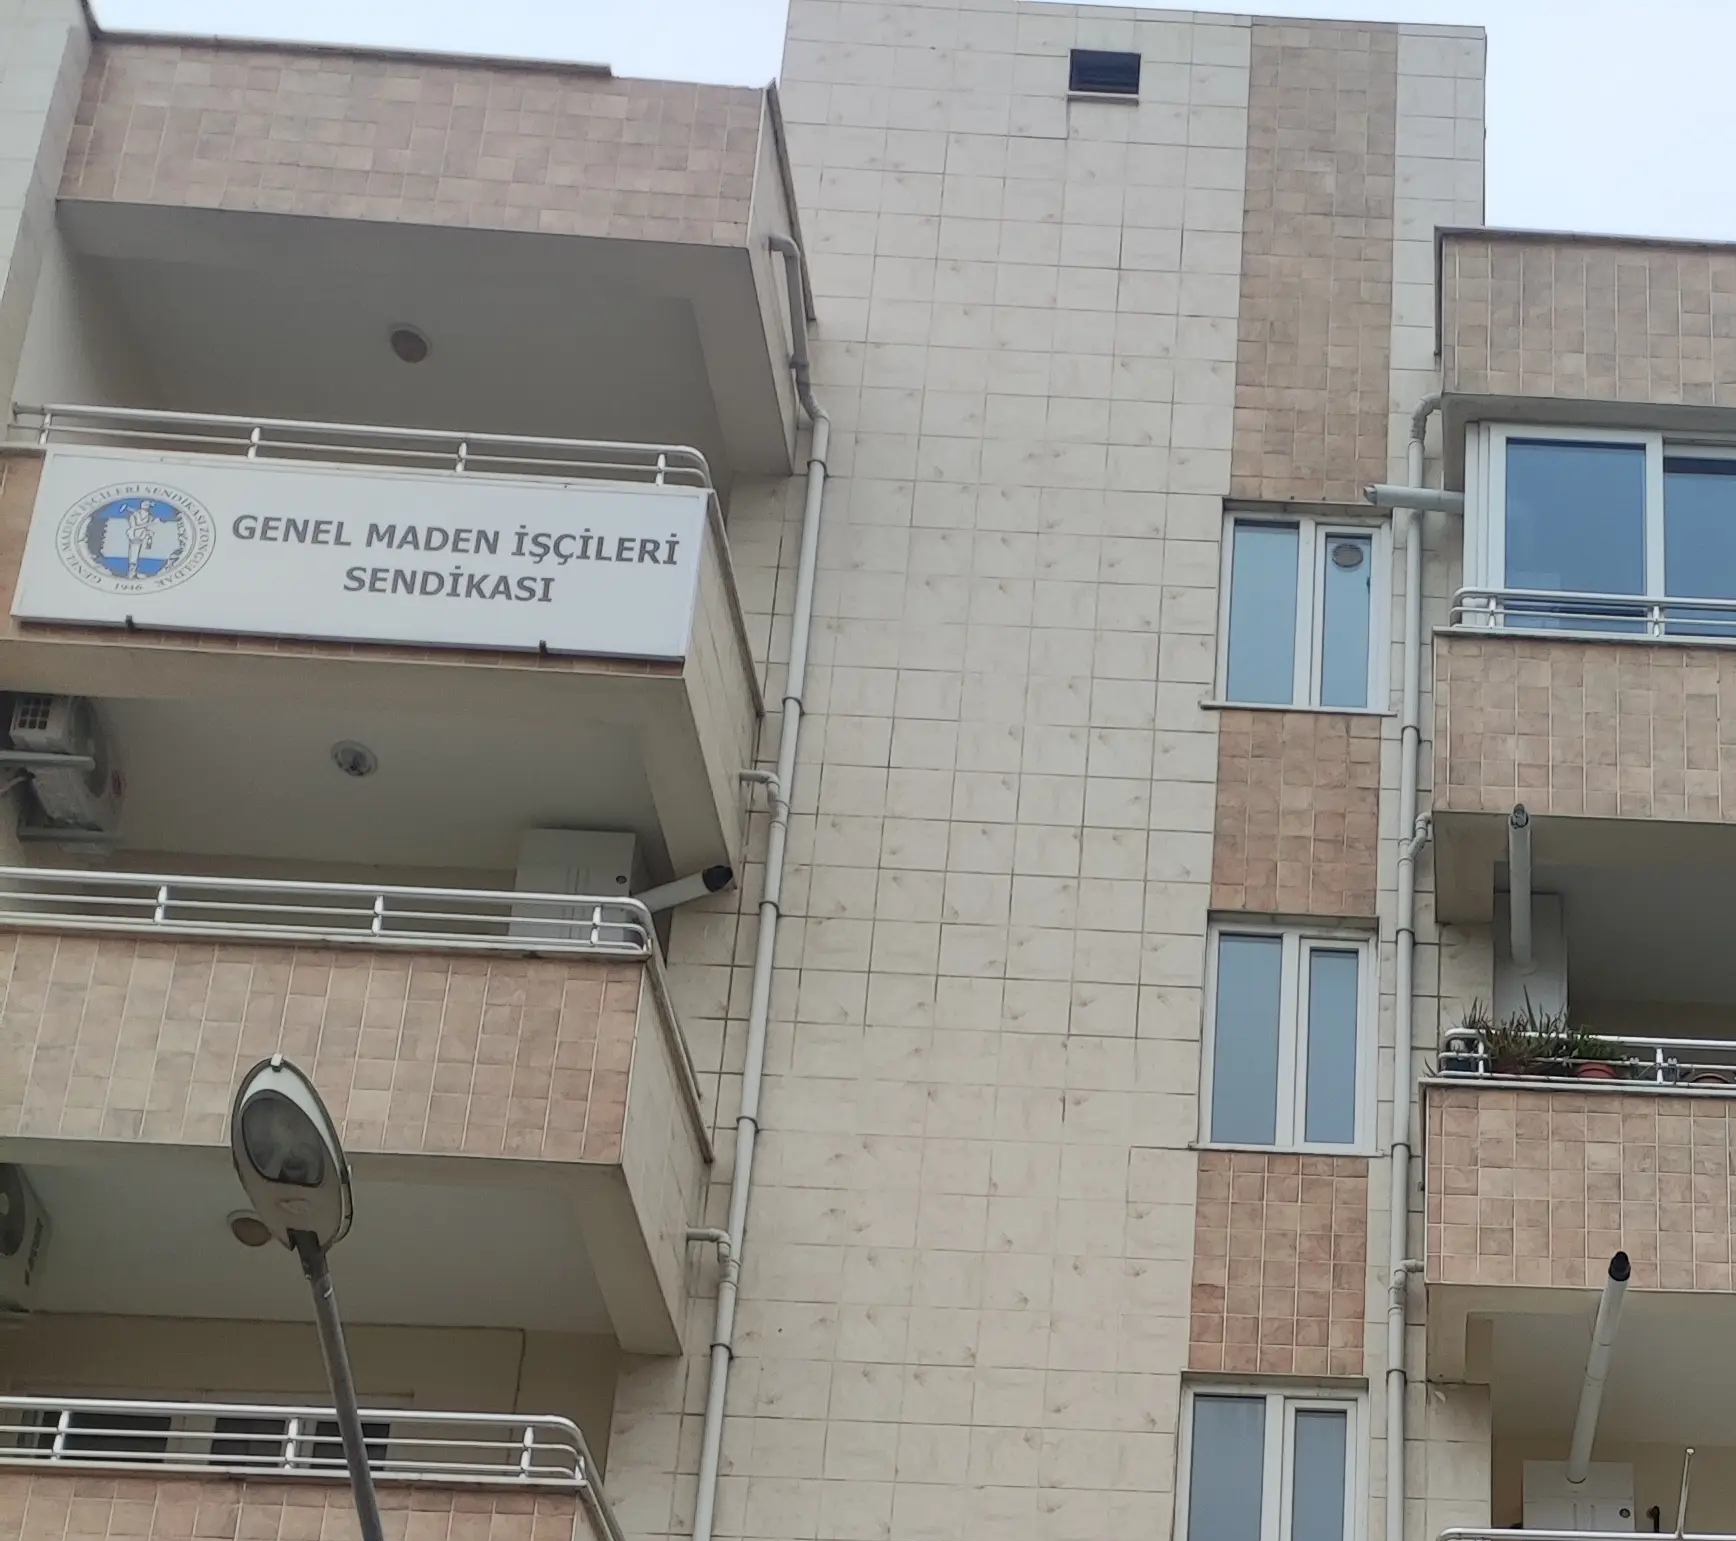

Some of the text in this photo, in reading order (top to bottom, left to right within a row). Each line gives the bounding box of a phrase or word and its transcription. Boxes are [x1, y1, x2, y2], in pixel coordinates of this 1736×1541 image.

[232, 514, 680, 567] GENEL MADEN İŞÇİLERİ
[343, 564, 554, 604] SENDİKASI
